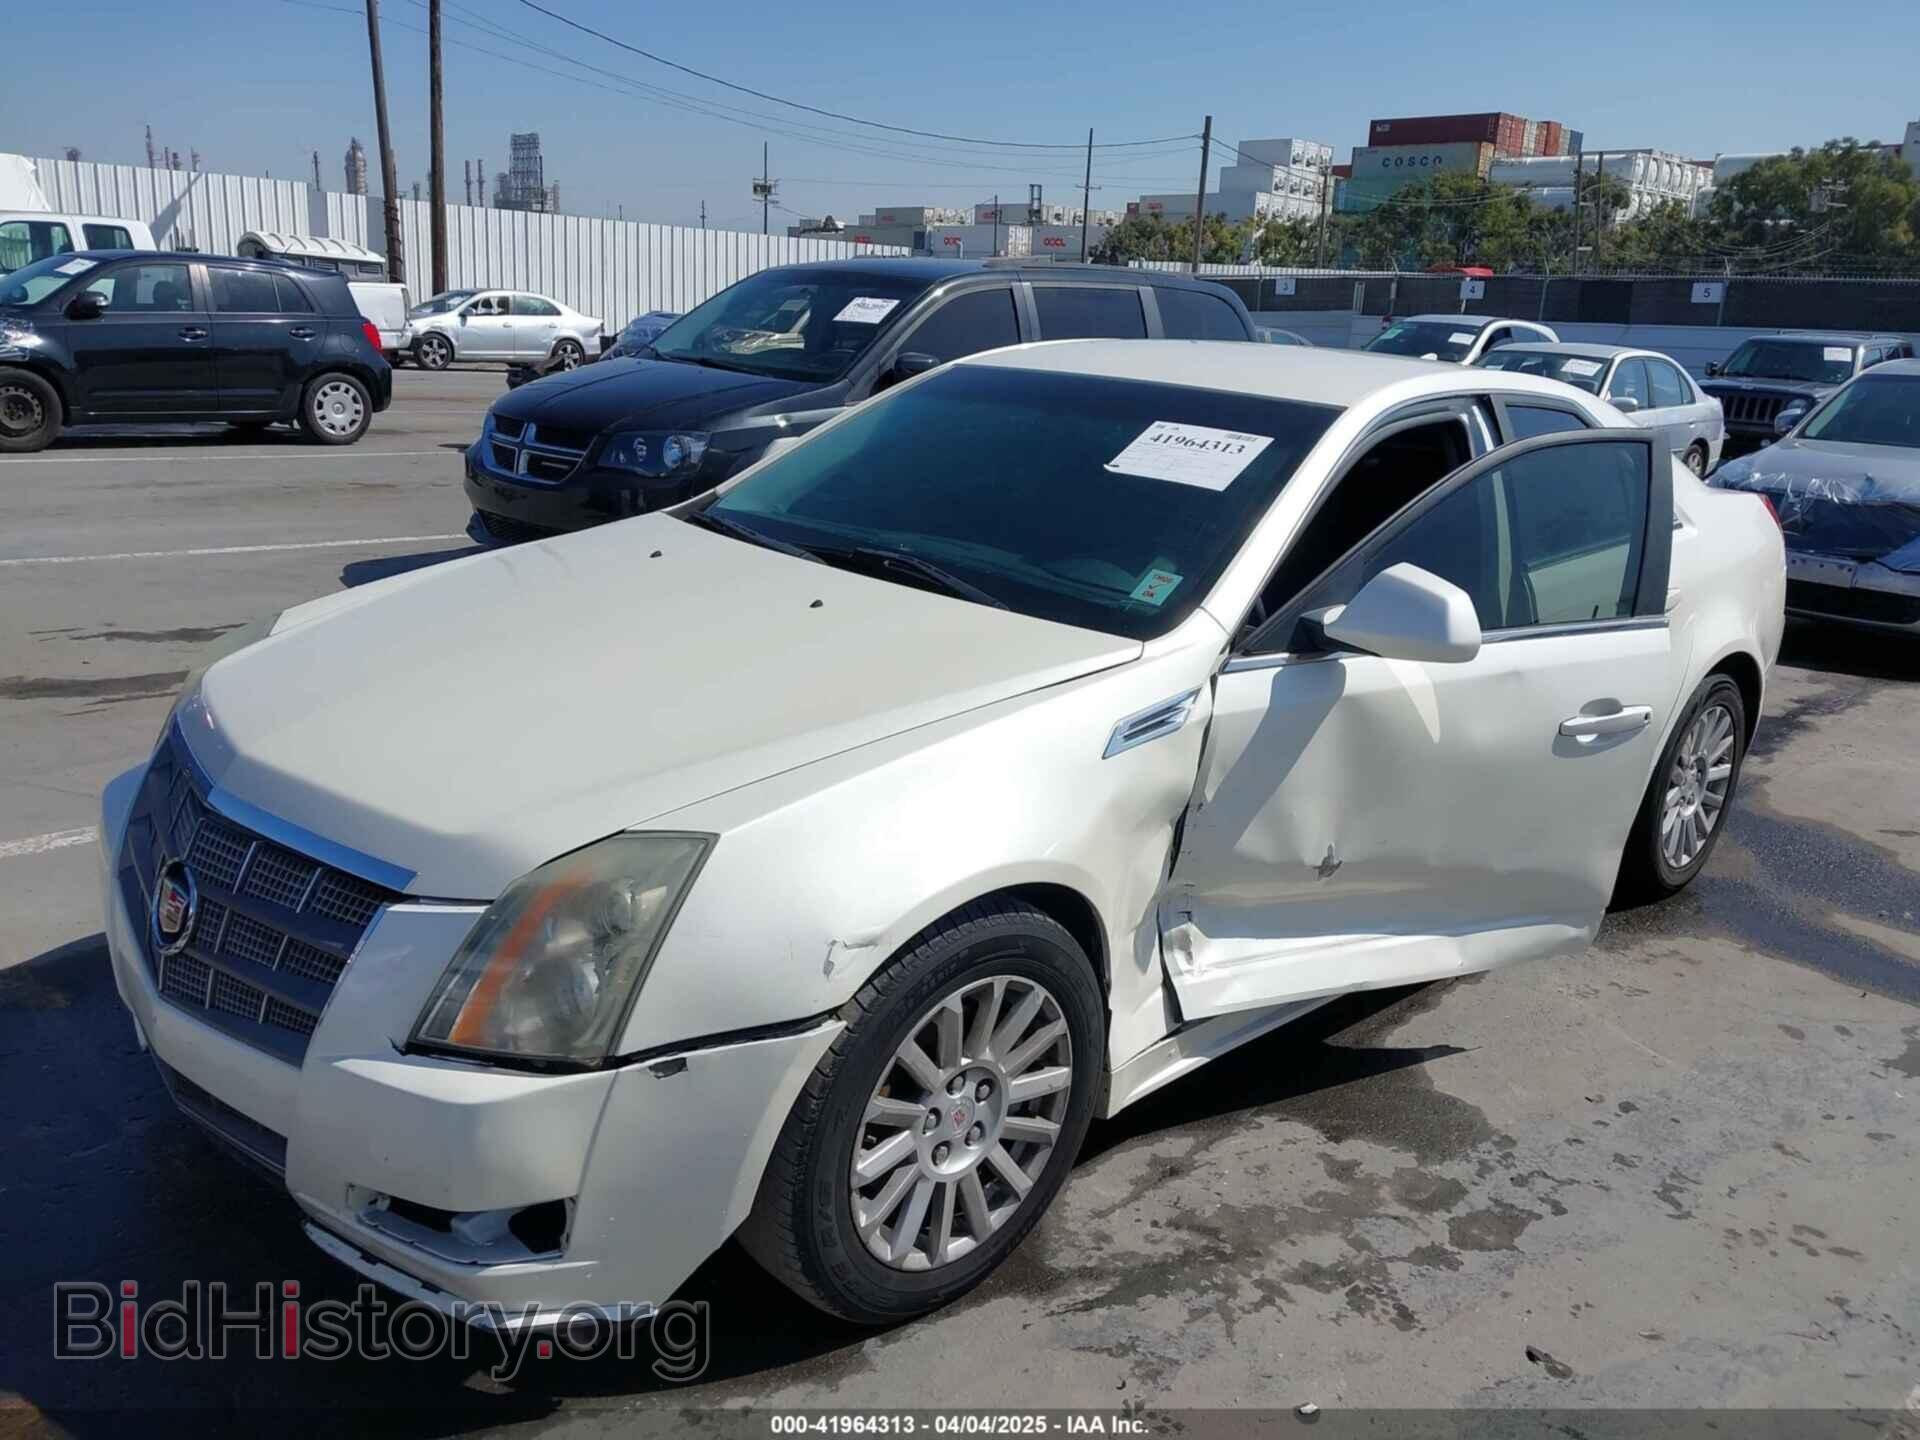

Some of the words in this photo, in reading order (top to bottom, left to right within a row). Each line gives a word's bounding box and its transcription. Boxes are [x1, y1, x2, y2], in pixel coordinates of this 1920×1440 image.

[1382, 155, 1443, 168] COSCO
[1703, 287, 1711, 298] 5
[1150, 433, 1246, 455] 41964313
